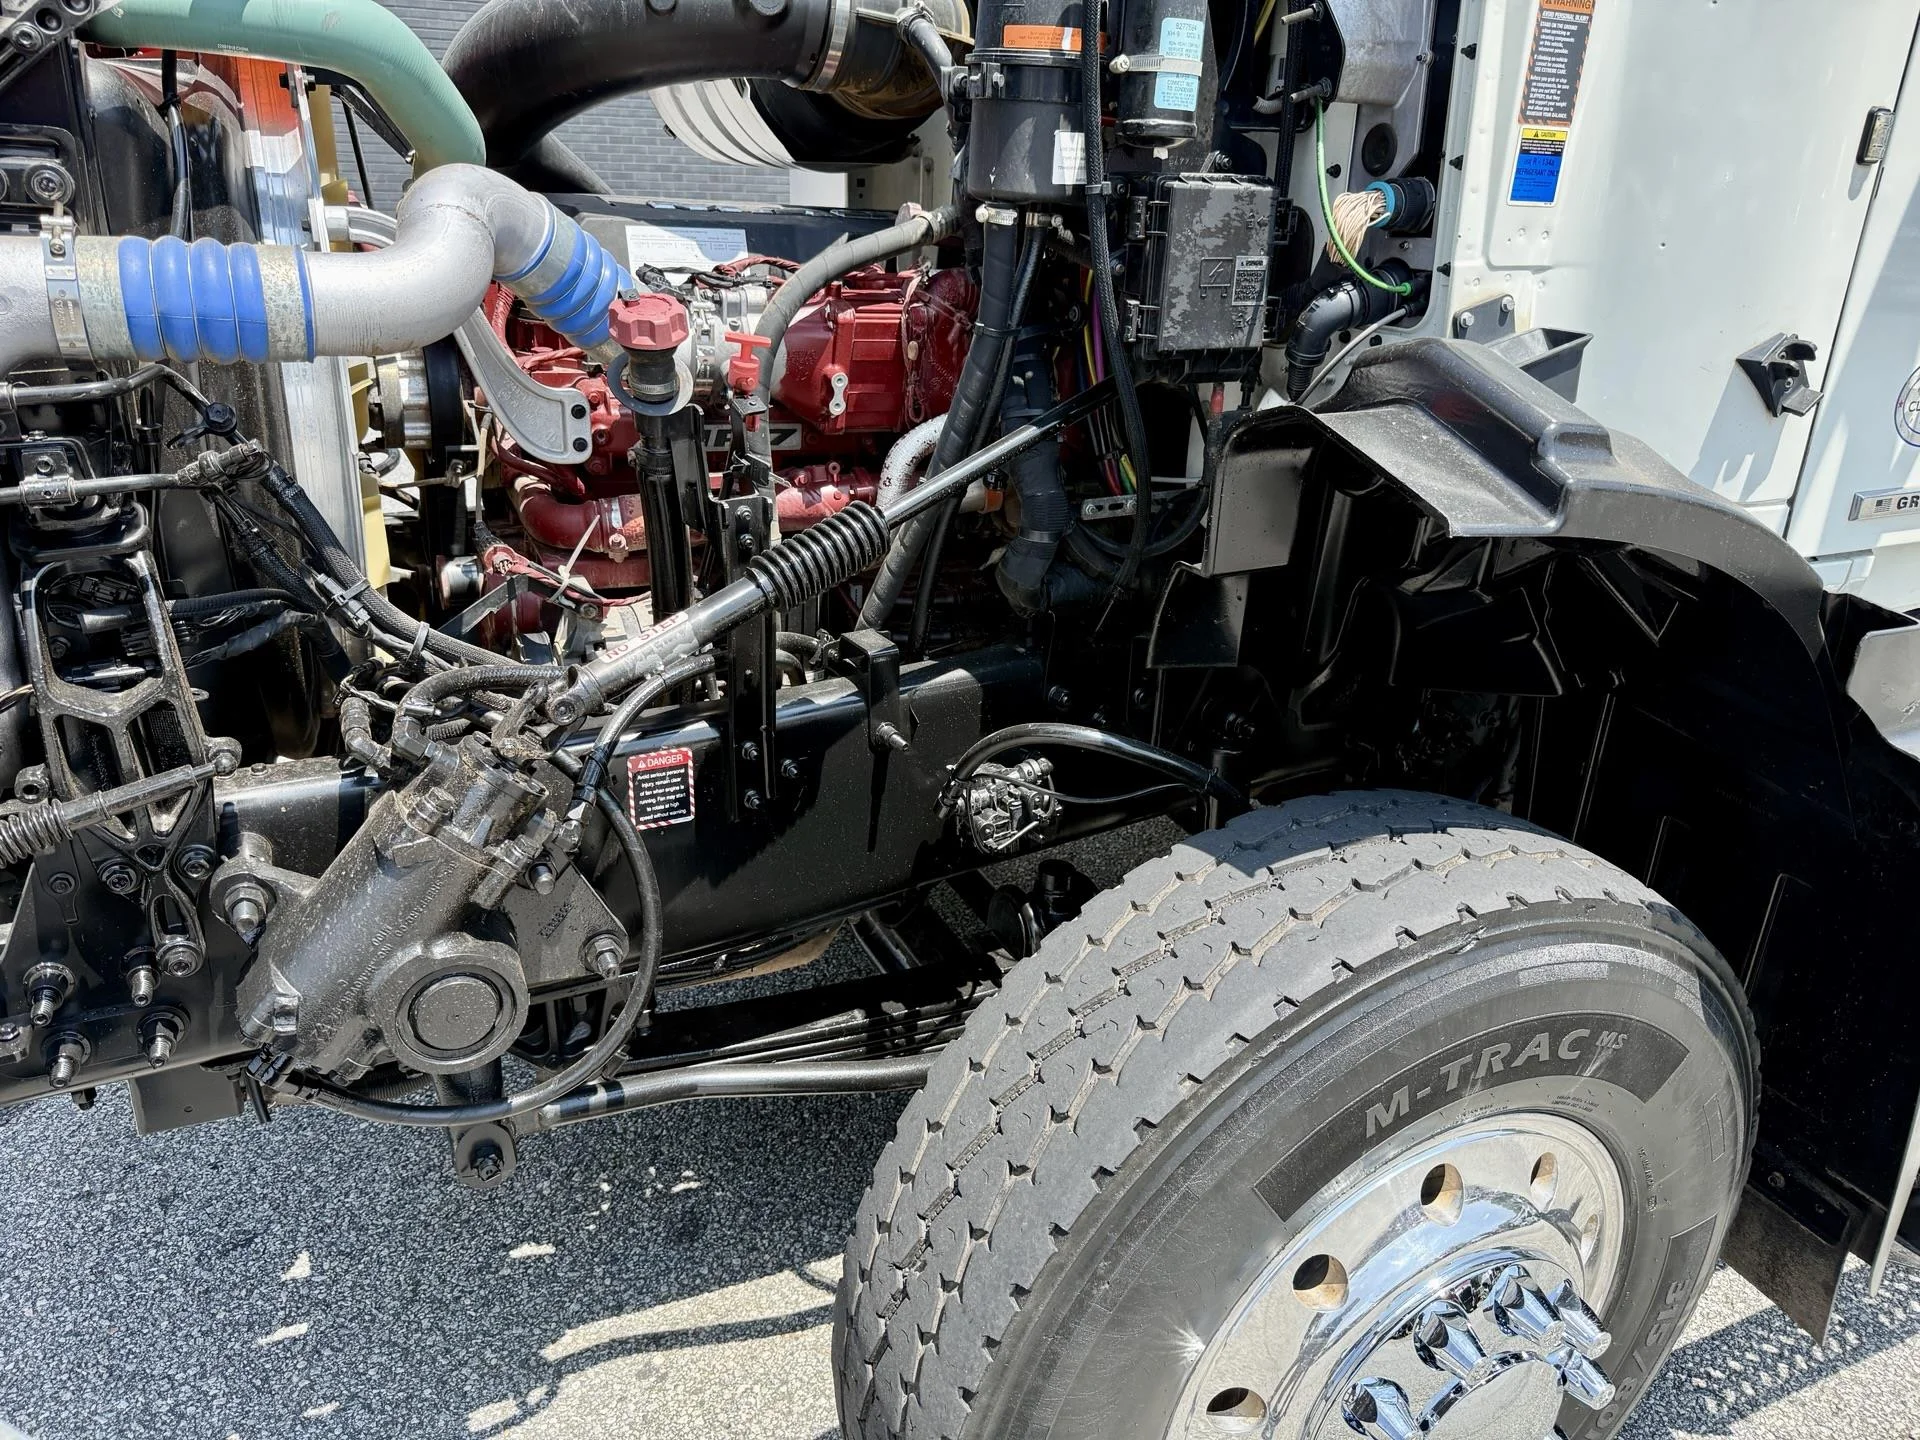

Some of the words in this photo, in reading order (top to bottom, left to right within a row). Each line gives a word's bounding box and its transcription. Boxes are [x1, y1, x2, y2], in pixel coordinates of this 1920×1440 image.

[1554, 0, 1591, 9] WARNING
[606, 644, 628, 659] NO
[639, 615, 679, 640] STEP
[648, 754, 683, 767] DANGER
[1366, 1028, 1590, 1138] M-TRAC
[1595, 1030, 1630, 1050] MS
